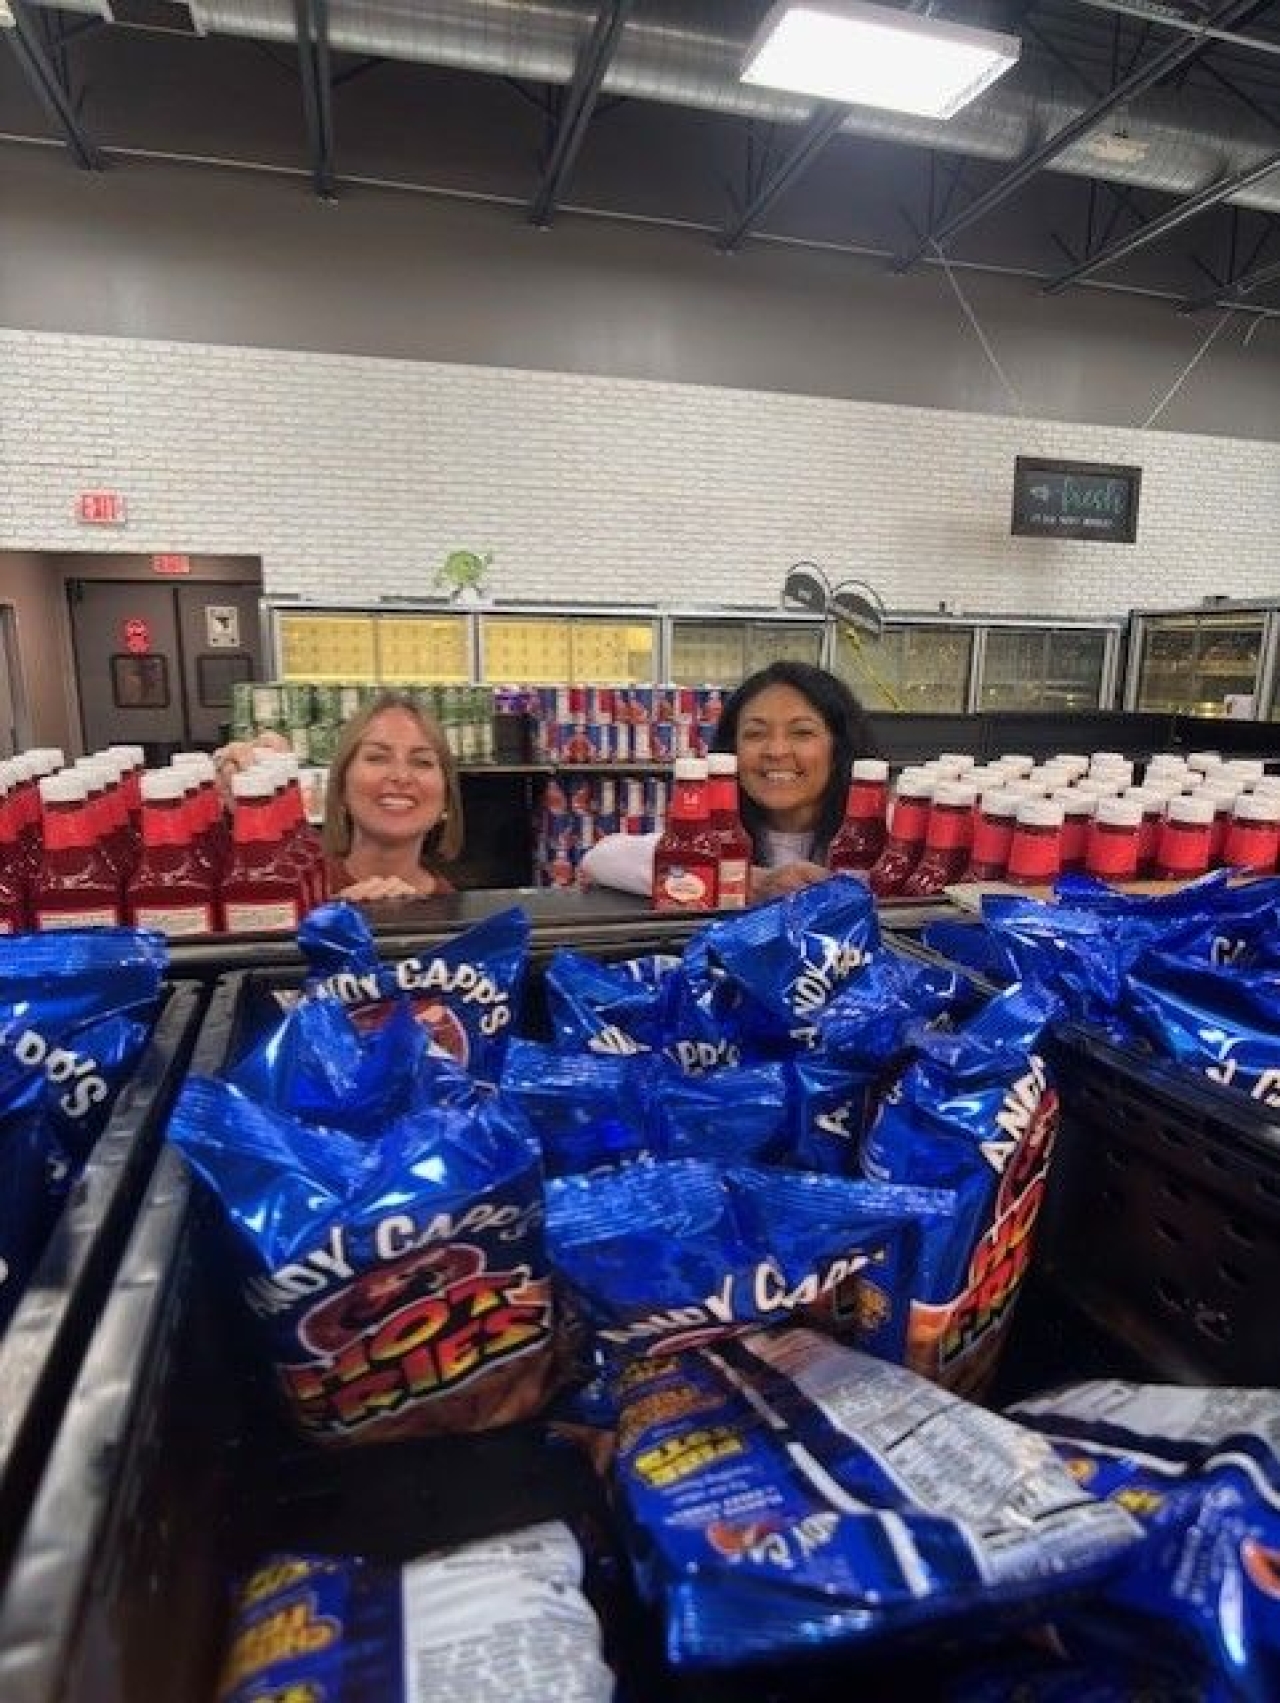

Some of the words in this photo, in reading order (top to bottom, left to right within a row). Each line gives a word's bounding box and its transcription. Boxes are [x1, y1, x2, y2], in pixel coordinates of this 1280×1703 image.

[82, 494, 119, 521] EXIT
[395, 957, 511, 1035] CAPP'S
[15, 1029, 108, 1118] PP'S
[302, 1304, 546, 1432] RIES
